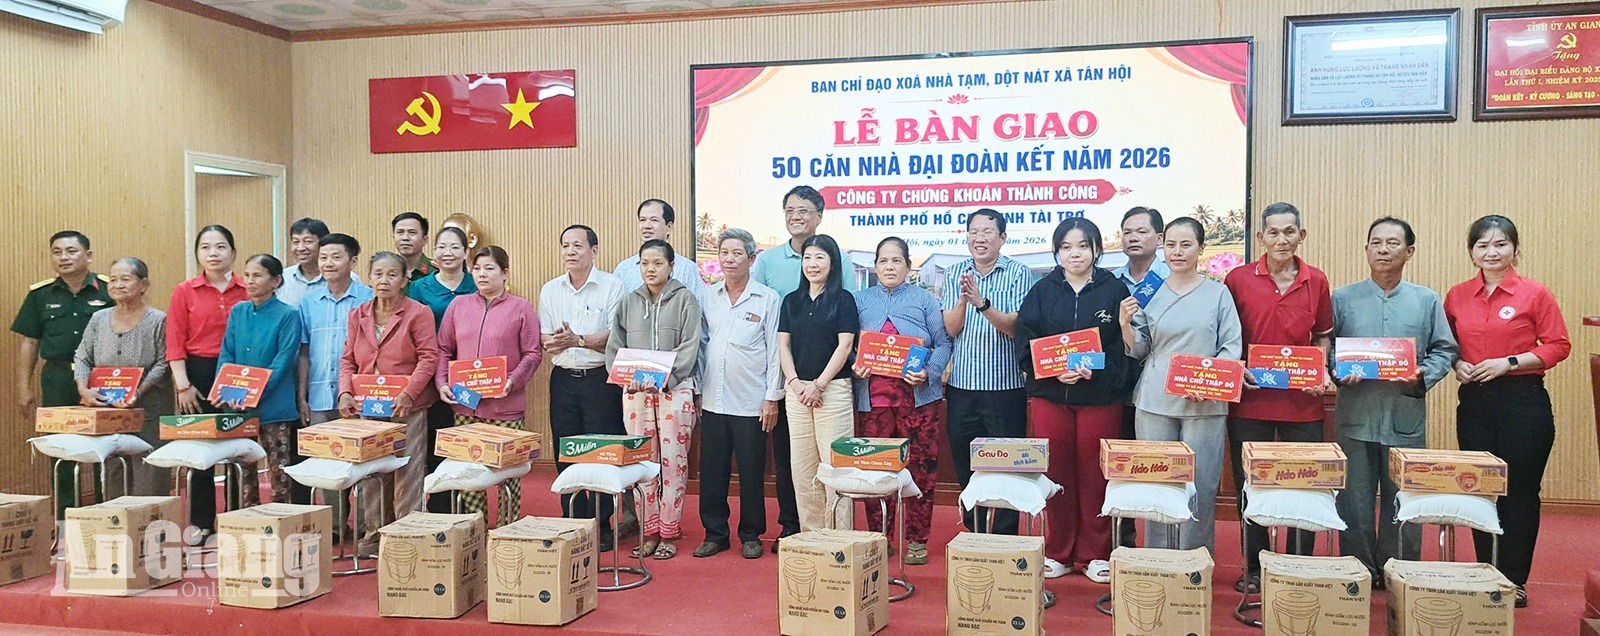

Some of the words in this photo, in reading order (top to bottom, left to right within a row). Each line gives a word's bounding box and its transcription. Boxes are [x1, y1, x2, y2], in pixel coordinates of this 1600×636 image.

[1526, 21, 1548, 32] TỈNH
[1550, 20, 1562, 30] ỦY
[1580, 22, 1600, 30] GIAN
[1552, 50, 1580, 60] Tặng
[812, 81, 836, 93] BAN
[842, 76, 862, 92] CHỈ
[866, 78, 892, 92] ĐẠO
[896, 74, 921, 89] XOÁ
[926, 72, 953, 88] NHÀ
[958, 74, 990, 89] TẠM,
[994, 70, 1020, 88] DỘT
[1024, 68, 1050, 84] NÁT
[1054, 66, 1072, 82] XÃ
[1077, 66, 1103, 81] TÂN
[1108, 64, 1132, 81] HỘI
[833, 108, 881, 146] LỄ
[894, 110, 980, 144] BÀN
[993, 110, 1099, 140] GIAO
[772, 156, 800, 178] 50
[810, 154, 850, 178] CĂN
[858, 152, 900, 176] NHÀ
[908, 154, 942, 179] ĐẠI
[950, 148, 1008, 174] ĐOÀN
[1016, 144, 1054, 172] KẾT
[1063, 145, 1111, 170] NĂM
[1120, 146, 1170, 169] 2026
[836, 188, 876, 206] CÔNG
[880, 190, 896, 204] TY
[902, 186, 949, 204] CHỨNG
[953, 186, 1002, 202] KHOÁN
[1006, 184, 1054, 201] THÀNH
[1058, 182, 1098, 200] CÔNG
[850, 212, 894, 226] THÀNH
[900, 210, 928, 226] PHỐ
[934, 210, 951, 225] HỒ
[1030, 211, 1050, 224] TÀI
[923, 238, 946, 248] ngày
[1024, 236, 1046, 244] 2026
